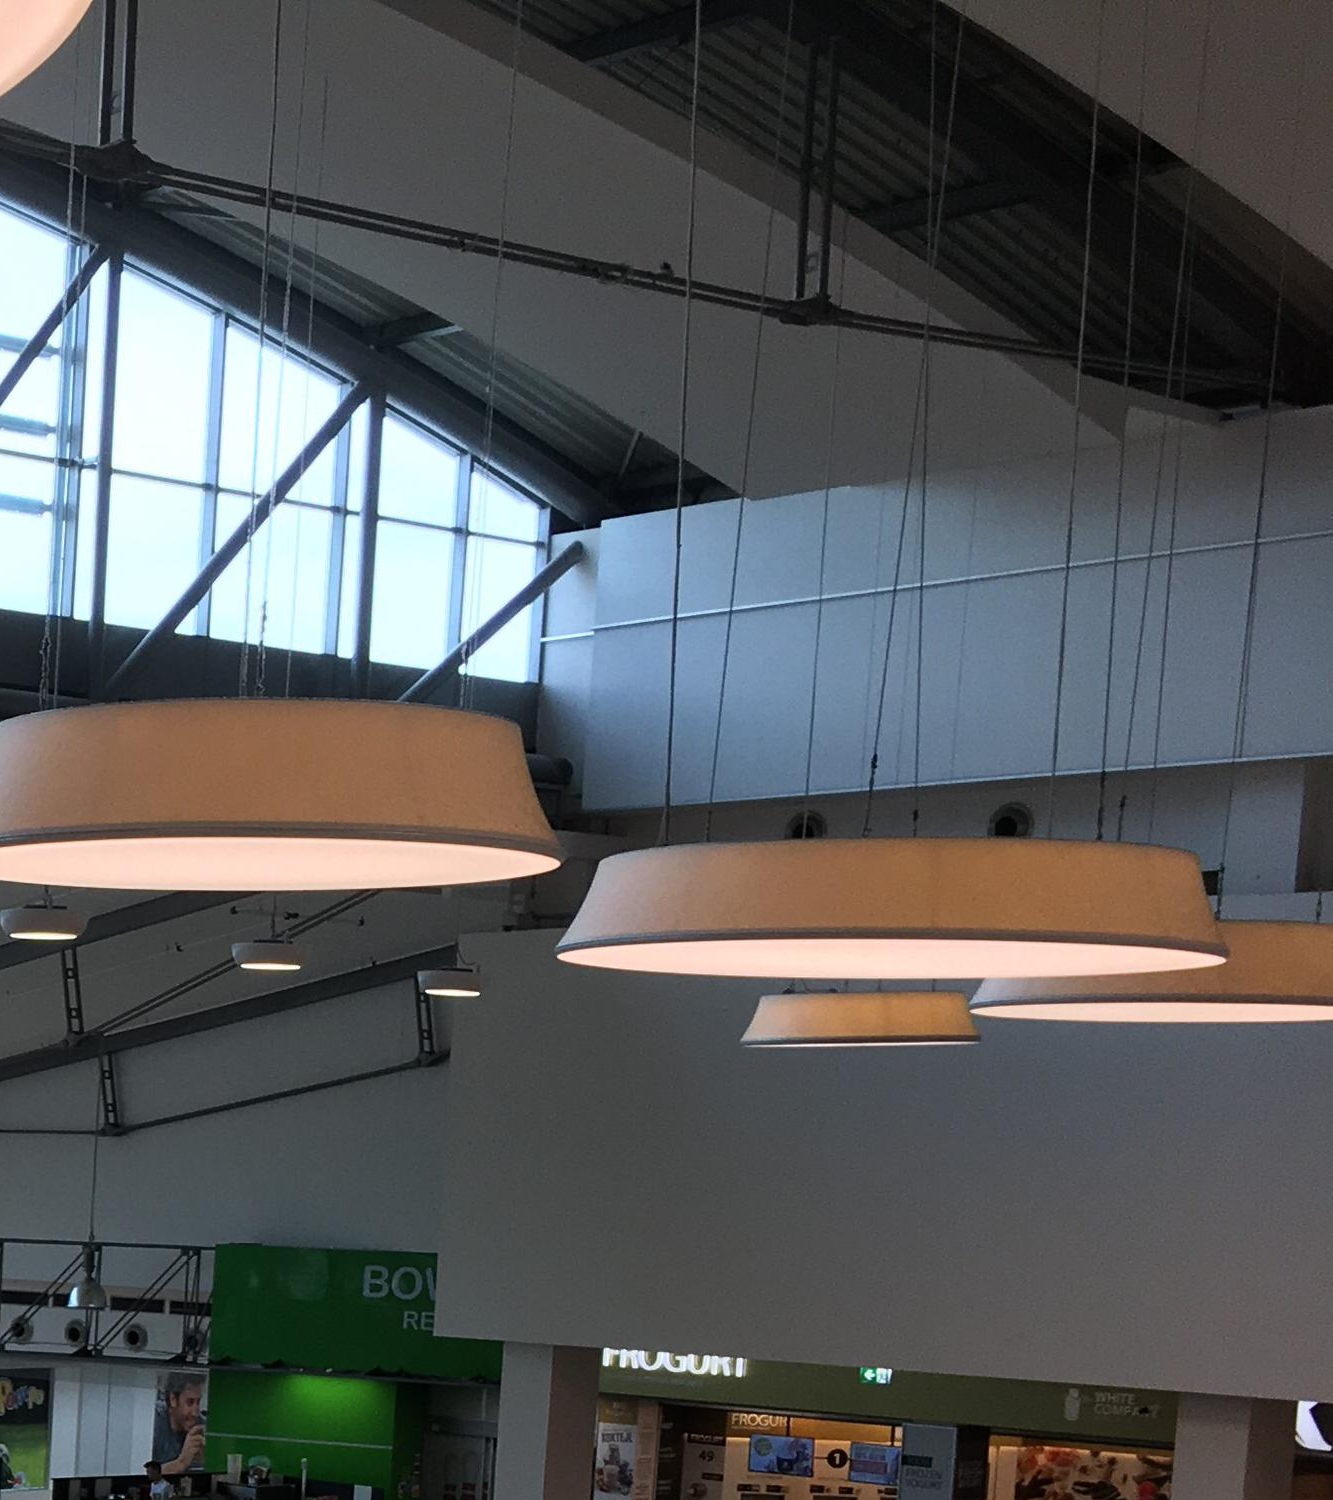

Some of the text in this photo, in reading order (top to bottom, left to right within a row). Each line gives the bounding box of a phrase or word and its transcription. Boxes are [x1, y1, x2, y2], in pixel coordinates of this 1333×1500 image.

[363, 1265, 437, 1302] BO
[1095, 1391, 1136, 1405] WHITE
[732, 1412, 790, 1427] FROGUR
